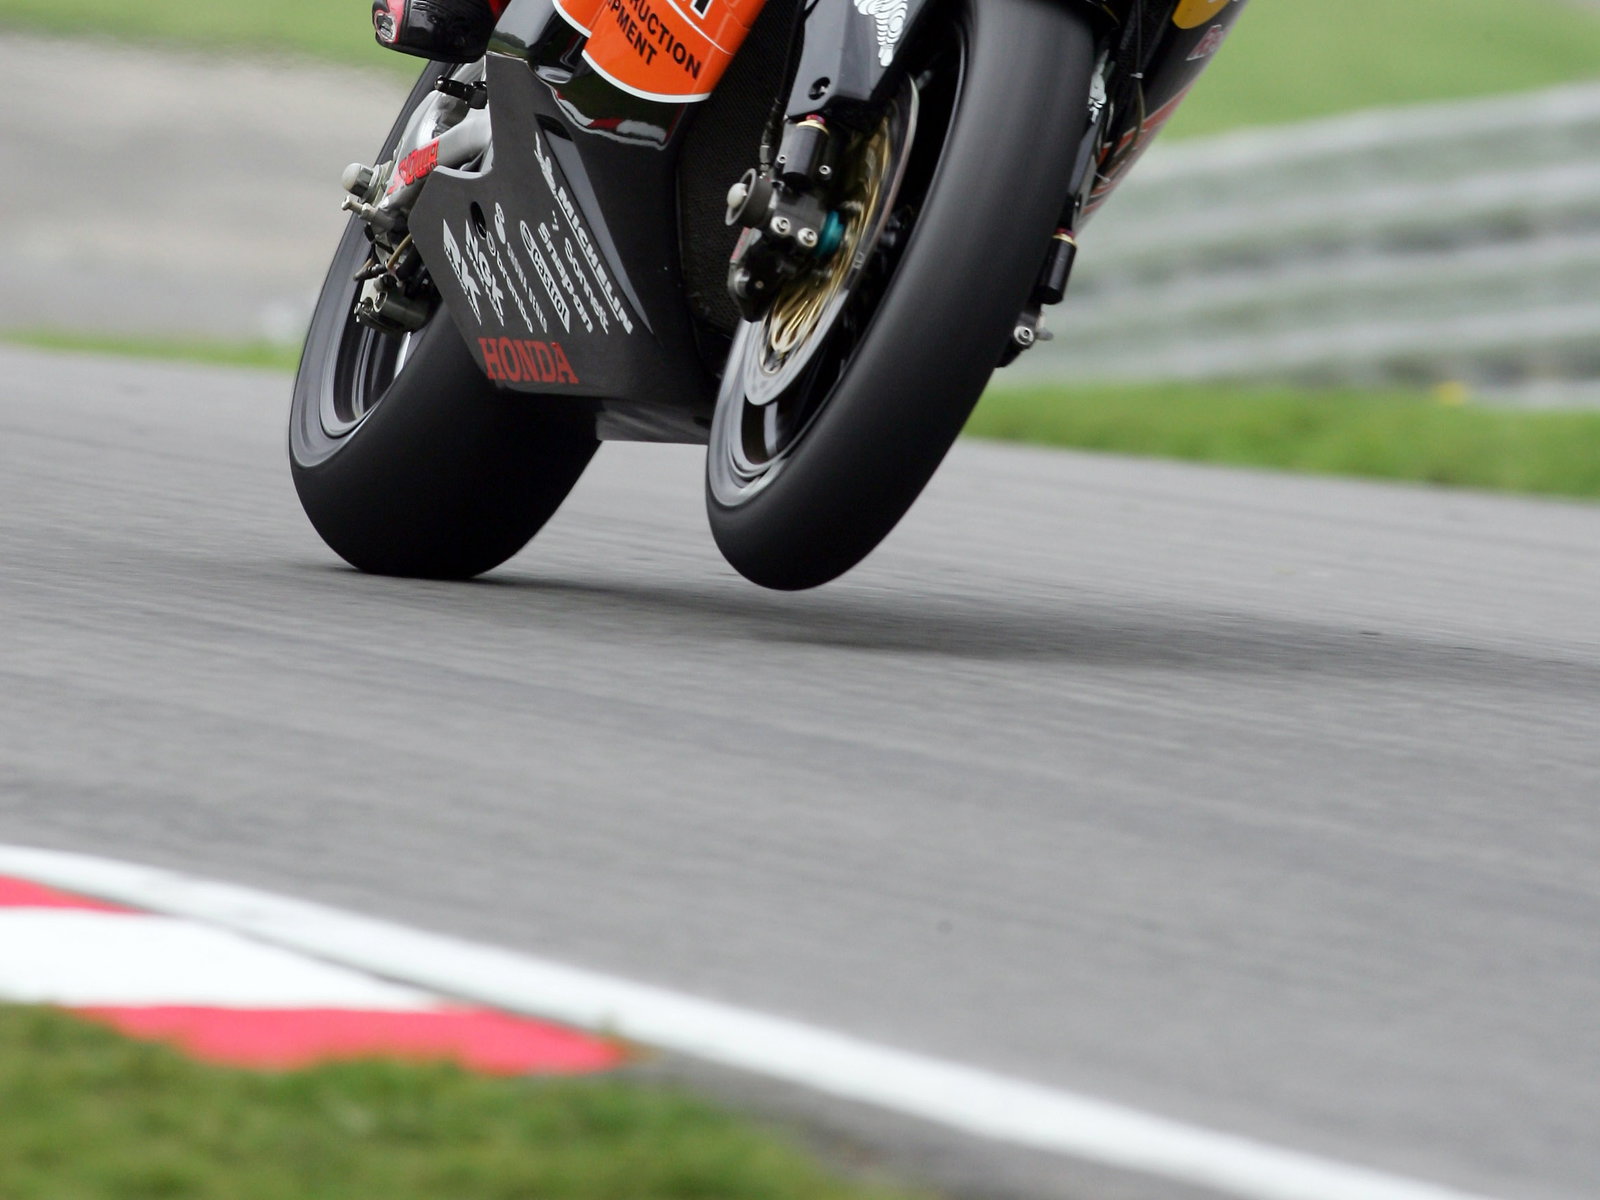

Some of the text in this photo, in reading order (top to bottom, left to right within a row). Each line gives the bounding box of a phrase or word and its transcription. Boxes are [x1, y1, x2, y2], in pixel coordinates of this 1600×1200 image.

[465, 219, 504, 317] NGK
[531, 247, 569, 322] Castrol
[557, 186, 634, 335] MICHELIN
[478, 336, 579, 384] HONDA
